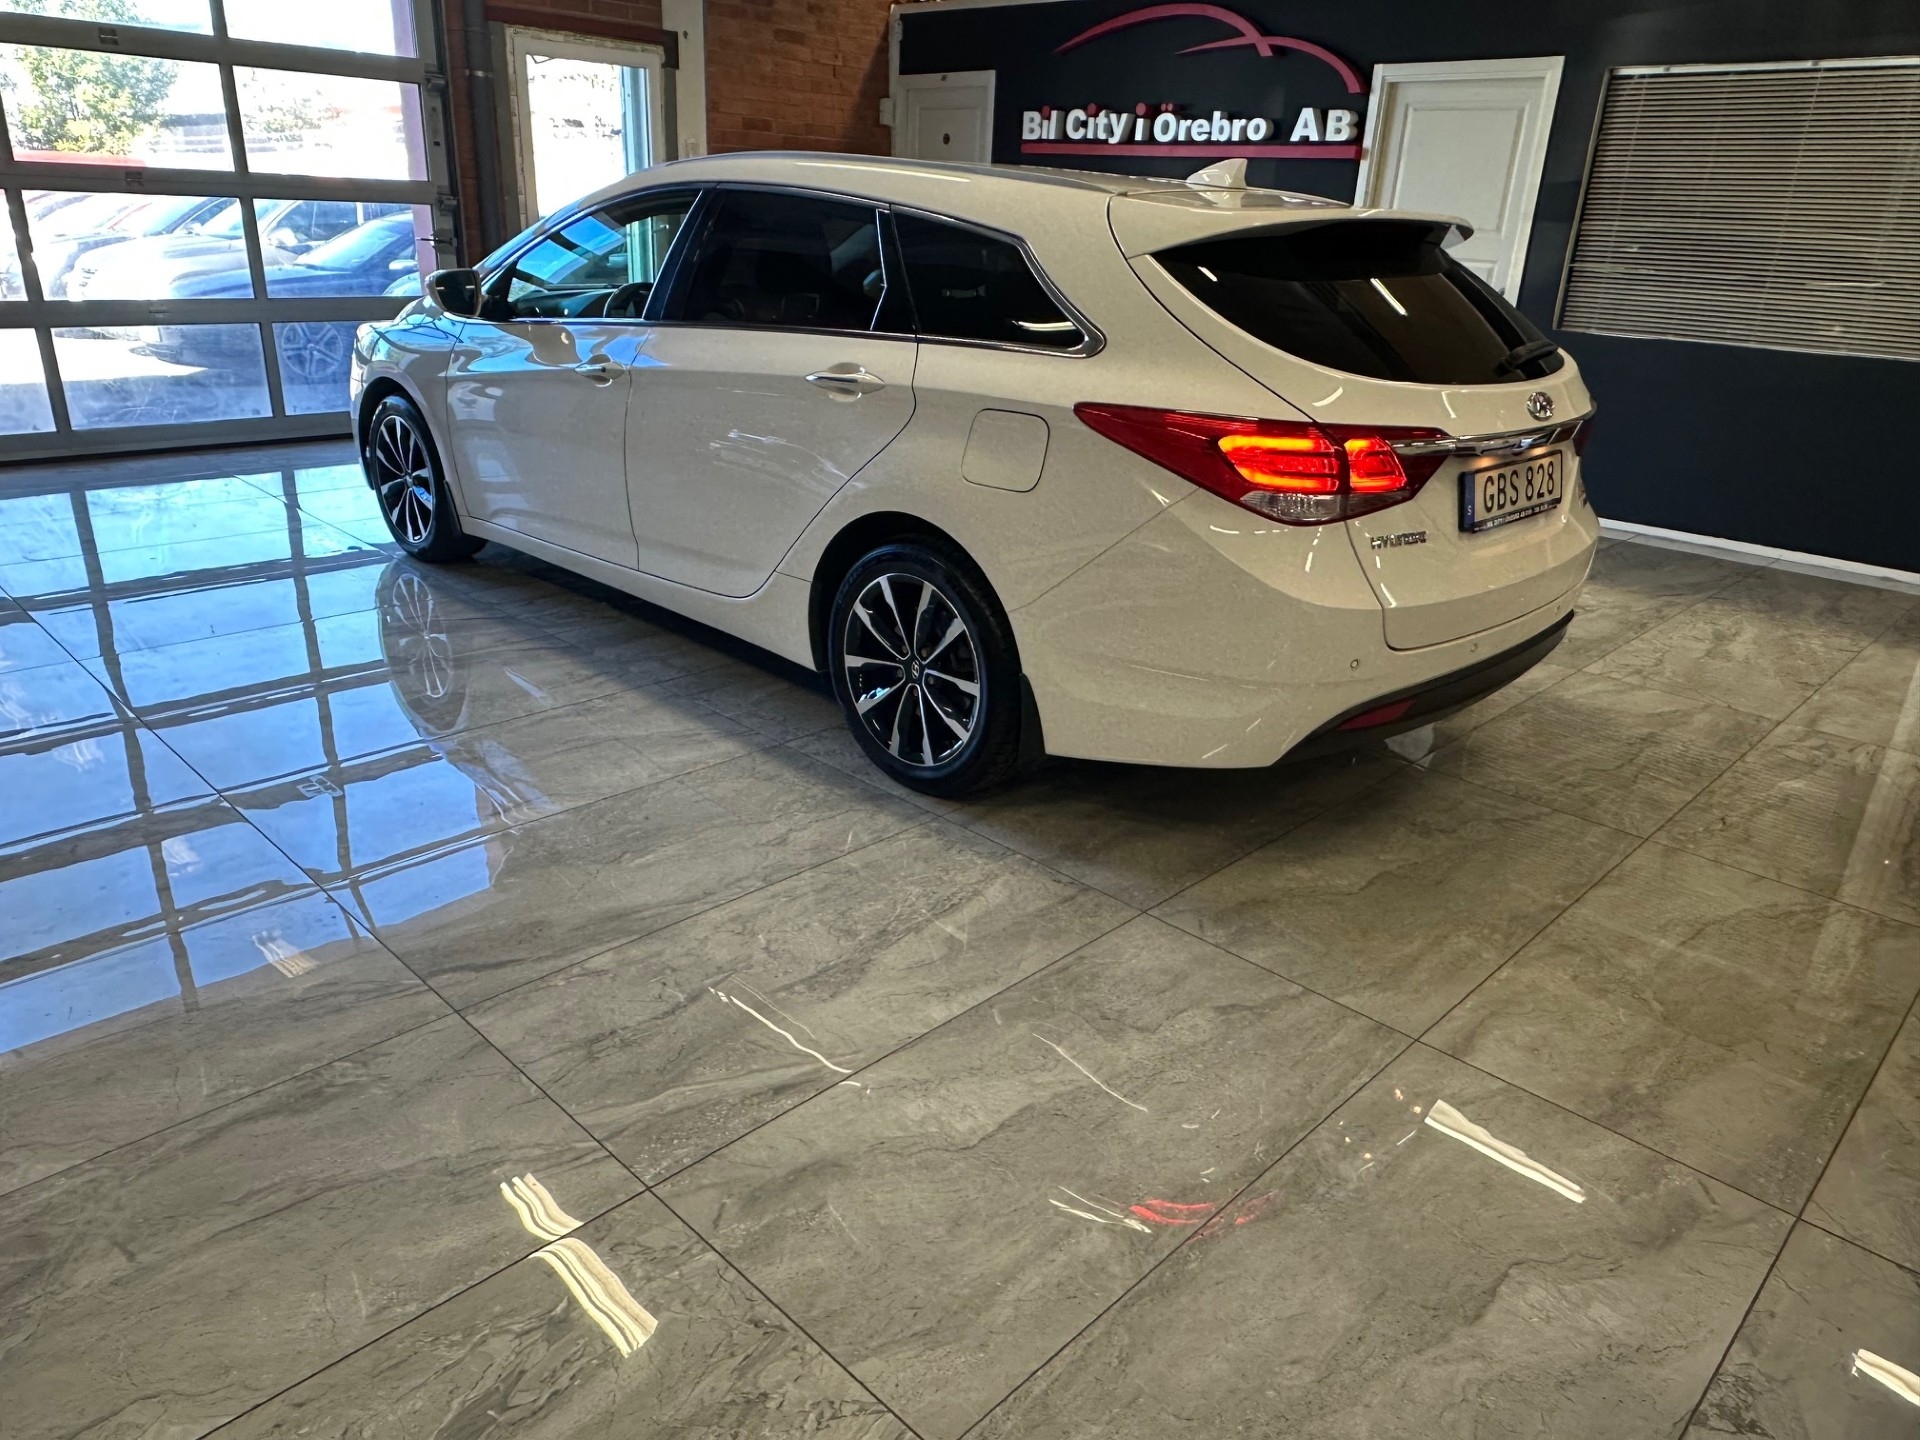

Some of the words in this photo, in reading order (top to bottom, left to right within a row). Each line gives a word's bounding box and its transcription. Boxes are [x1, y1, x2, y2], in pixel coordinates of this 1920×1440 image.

[1022, 104, 1061, 140] Bil
[1065, 102, 1132, 144] City
[1134, 101, 1149, 141] i
[1153, 102, 1270, 143] Örebro
[1290, 106, 1355, 142] AB
[1483, 469, 1519, 513] GBS
[1525, 460, 1555, 500] 828
